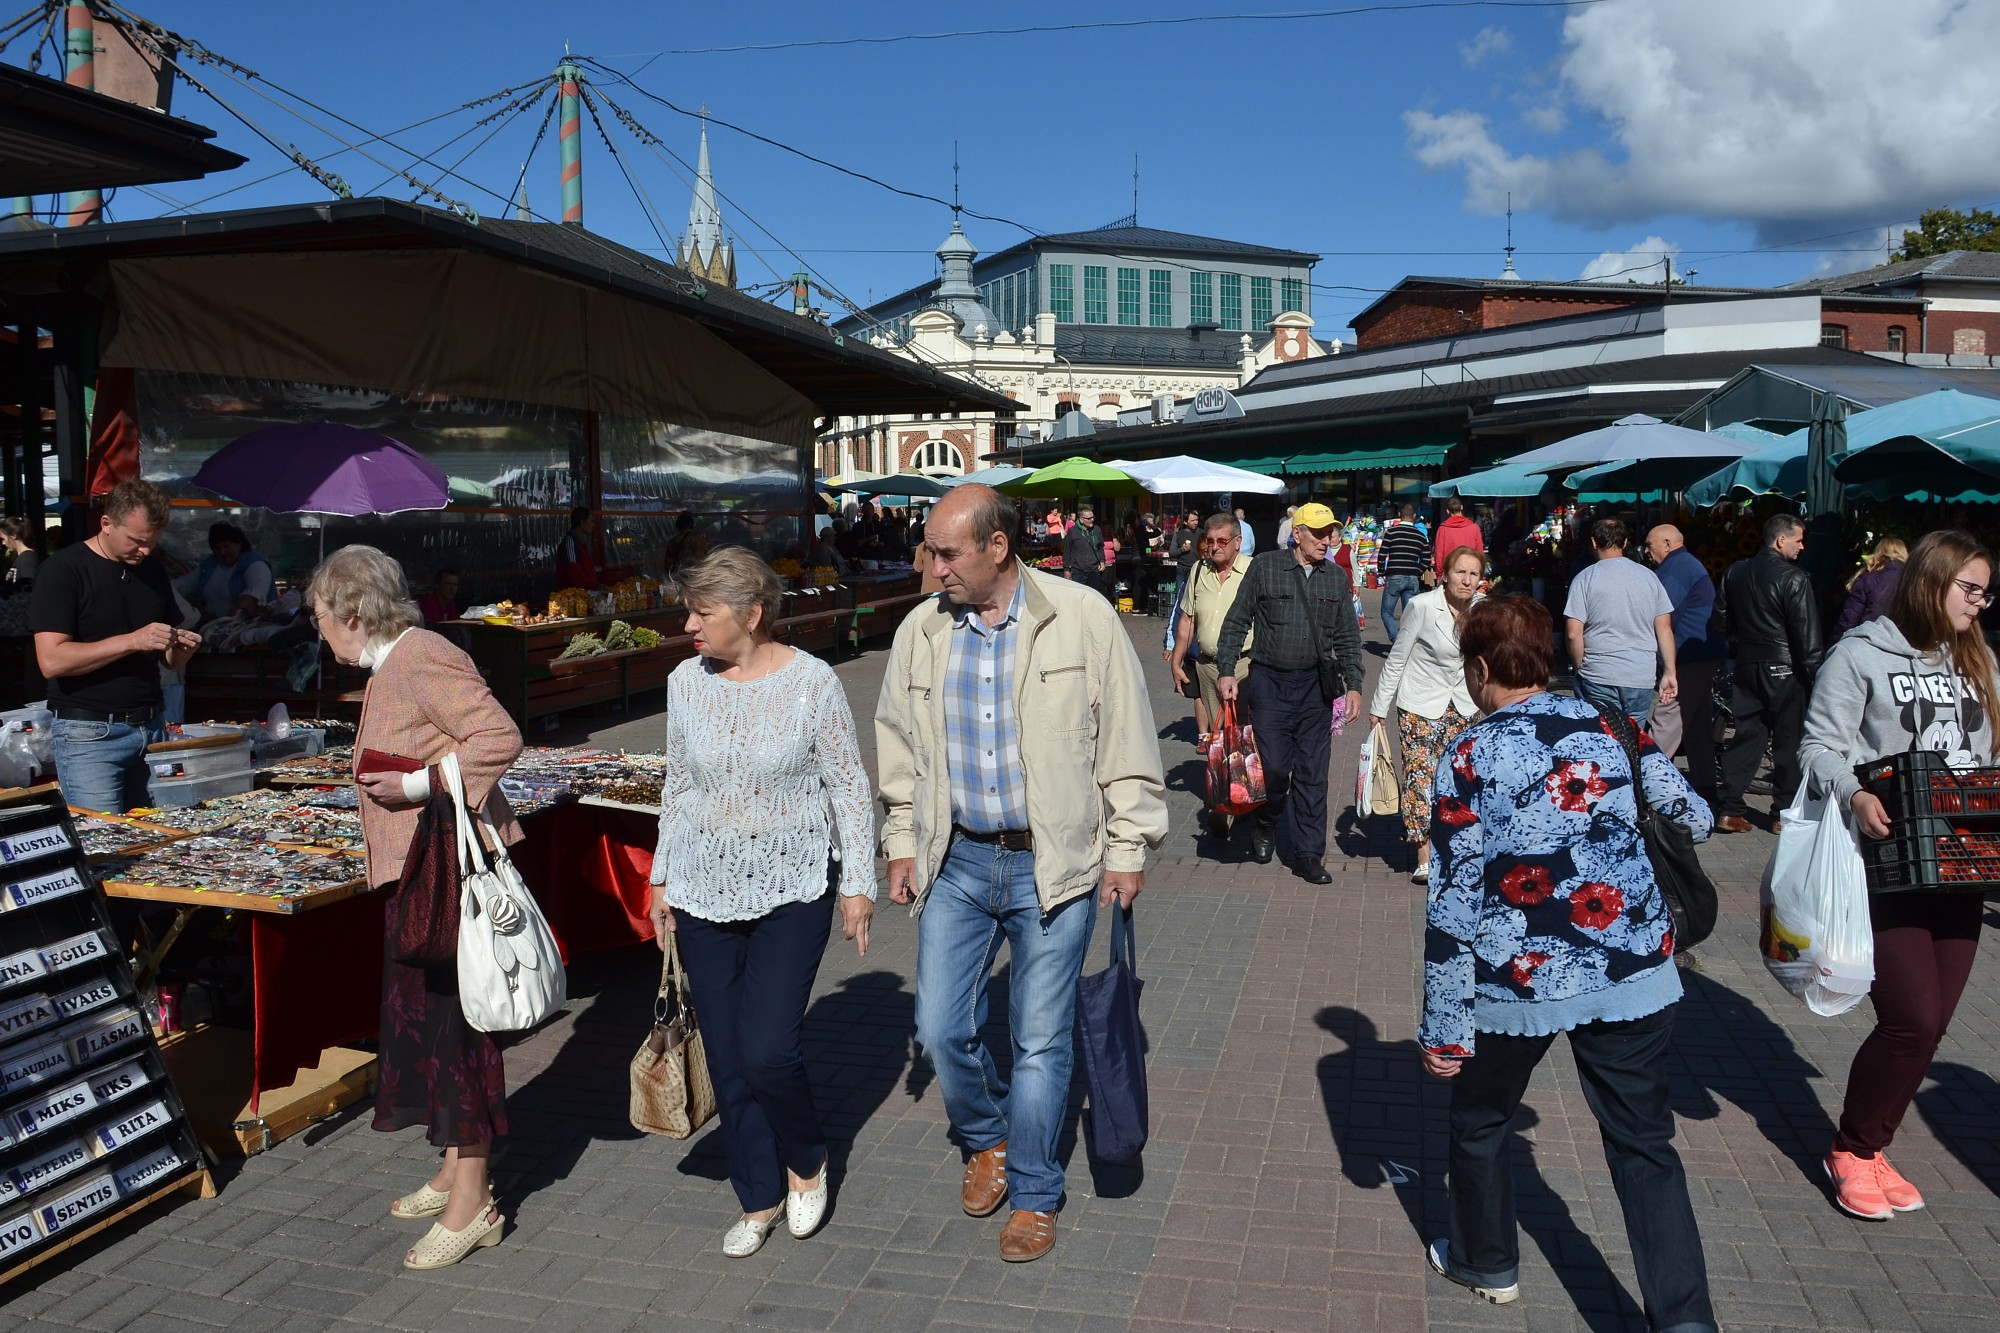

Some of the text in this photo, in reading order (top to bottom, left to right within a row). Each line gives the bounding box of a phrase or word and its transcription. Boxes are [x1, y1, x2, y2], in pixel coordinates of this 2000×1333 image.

[1197, 390, 1223, 409] AGMA
[13, 834, 66, 855] AUSTRA
[16, 876, 80, 905] LV DANIELA
[49, 941, 98, 966] EGILS
[59, 985, 112, 1013] IVARS
[0, 1006, 51, 1033] VITA
[90, 1022, 139, 1052] LĀSMA
[5, 1054, 65, 1084] KLAUDIJA
[26, 1093, 86, 1132] LV MIKS
[106, 1111, 159, 1148] LV RITA
[22, 1148, 84, 1183] PĒTERIS
[123, 1155, 176, 1187] TATJANA
[48, 1185, 112, 1230] LV SENTIS
[0, 1225, 32, 1252] IVO
